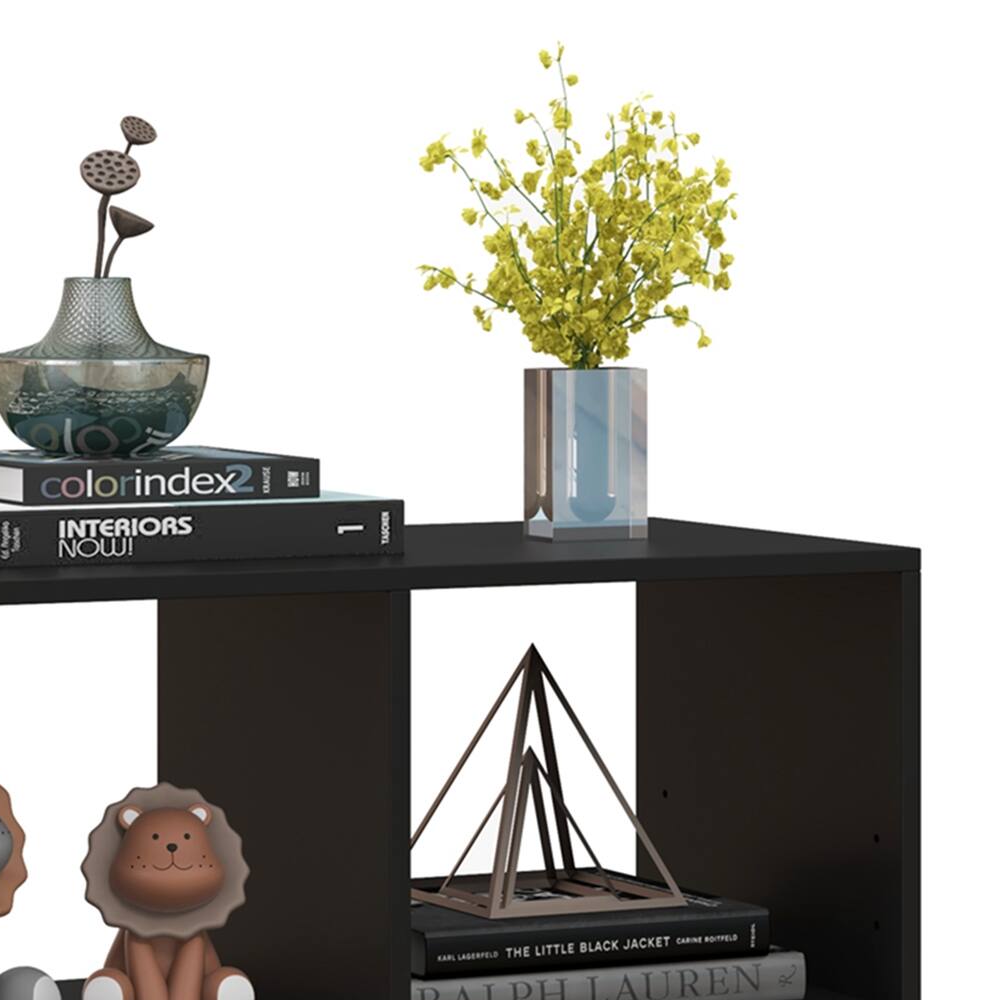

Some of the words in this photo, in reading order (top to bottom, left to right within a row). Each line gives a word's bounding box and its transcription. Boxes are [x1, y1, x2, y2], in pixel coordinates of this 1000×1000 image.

[59, 516, 193, 538] INTERIORS
[337, 524, 363, 534] 1
[381, 511, 390, 544] TASCHEN
[59, 538, 132, 558] NOW!
[505, 947, 531, 959] THE
[535, 942, 575, 957] LITTLE
[579, 939, 619, 954] BLACK
[623, 936, 670, 951] JACKET
[676, 936, 702, 945] CARINE
[437, 954, 456, 962] KARL
[457, 950, 499, 961] LAGERFELD
